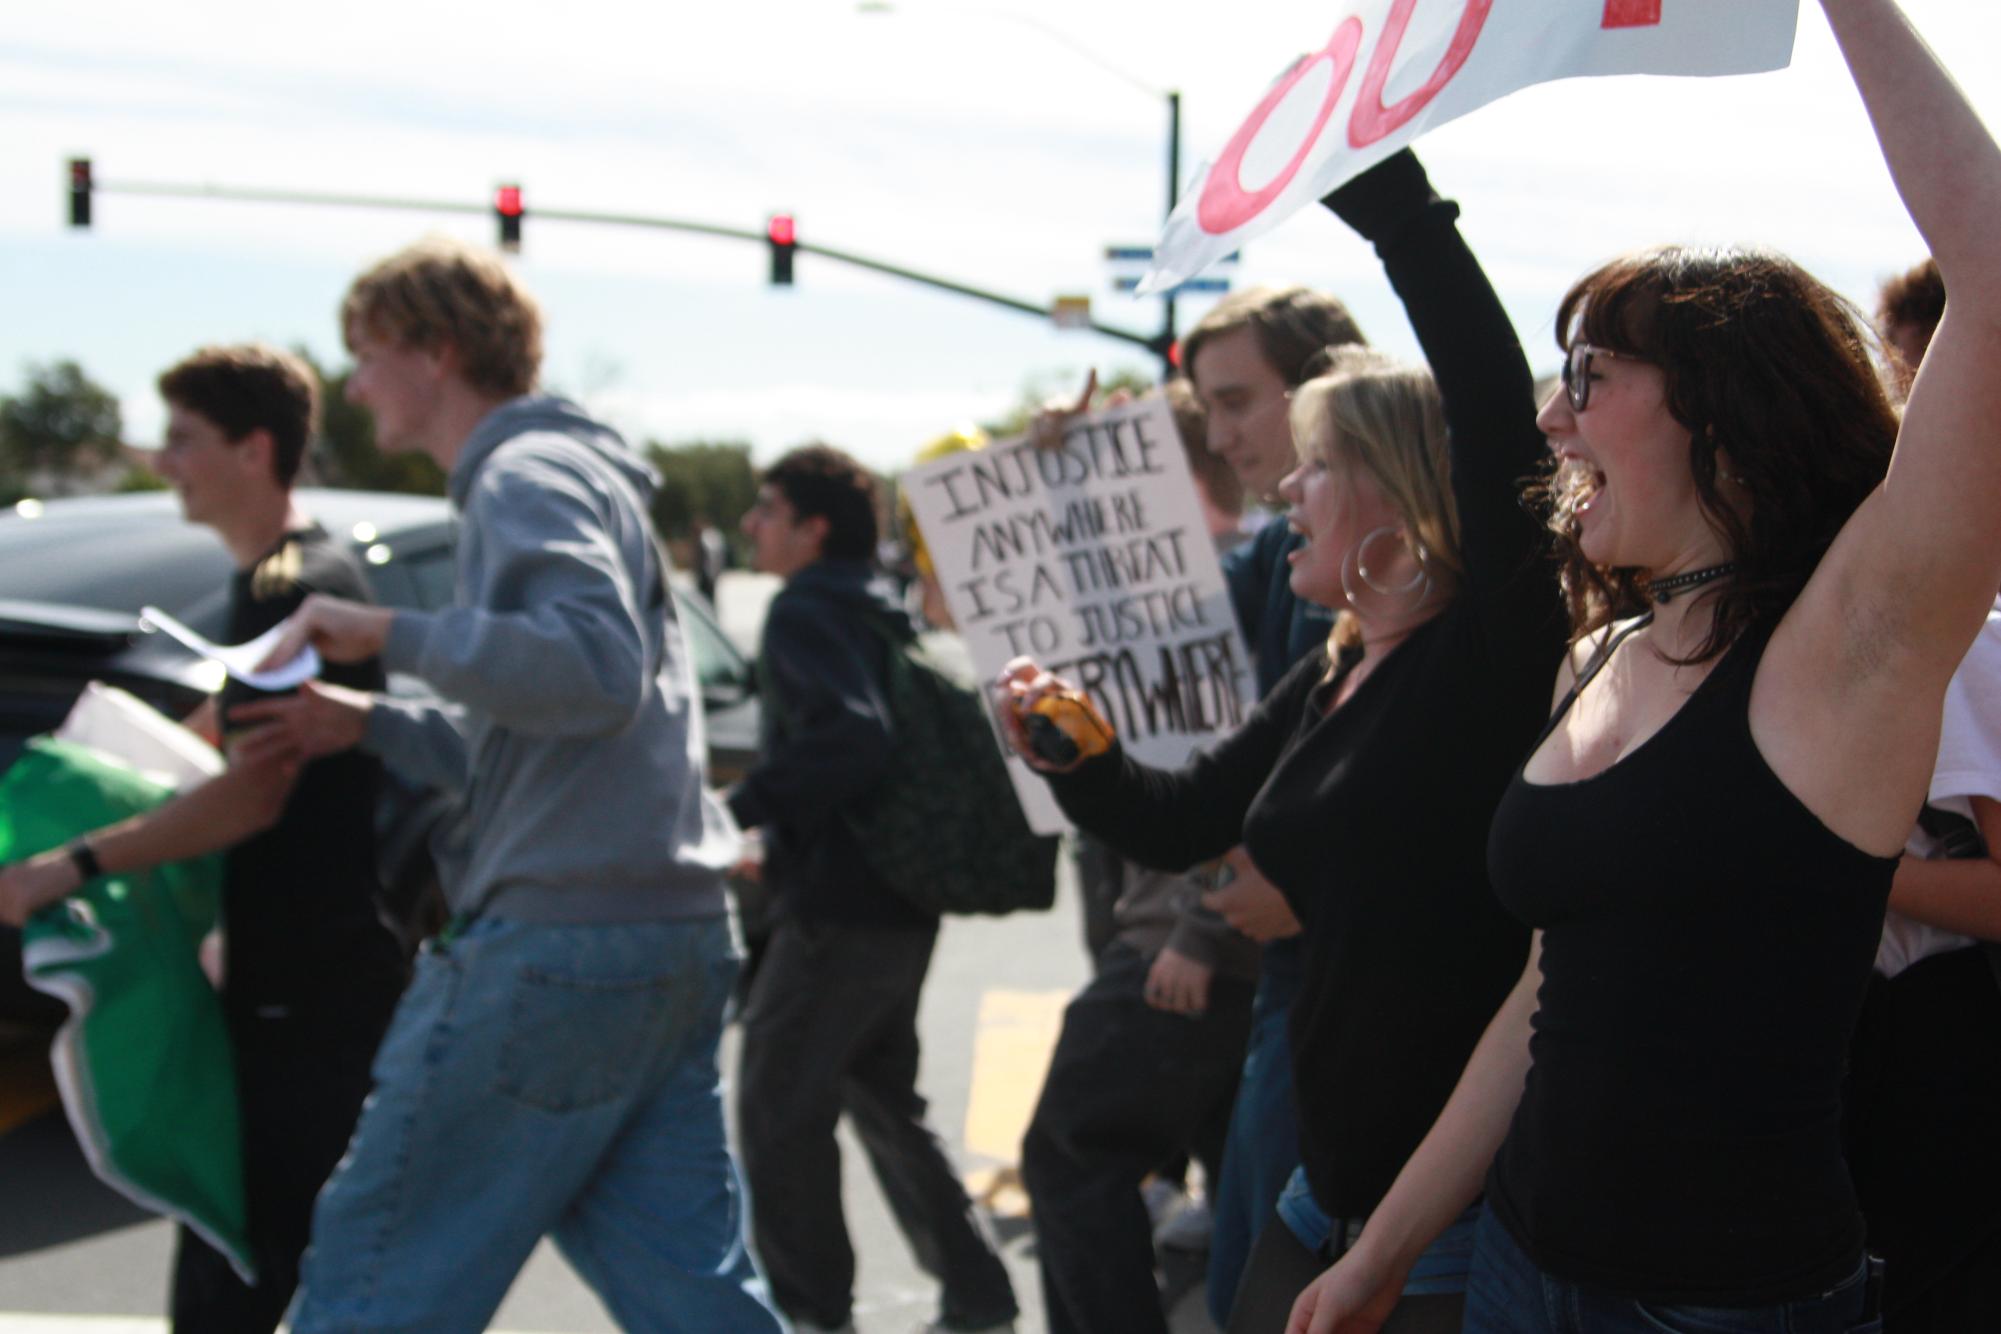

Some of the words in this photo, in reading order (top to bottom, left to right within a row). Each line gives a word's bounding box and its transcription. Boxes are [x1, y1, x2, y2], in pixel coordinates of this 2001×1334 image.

[1195, 0, 1663, 235] OU
[924, 413, 1165, 523] INJUSTICE
[957, 570, 1026, 622] IS
[1030, 562, 1064, 604] A
[1059, 525, 1187, 595] THREAT
[971, 487, 1150, 571] ANYWHERE
[991, 615, 1060, 660] TO
[1071, 583, 1209, 647] JUSTICE
[984, 627, 1248, 758] RYWHERE
